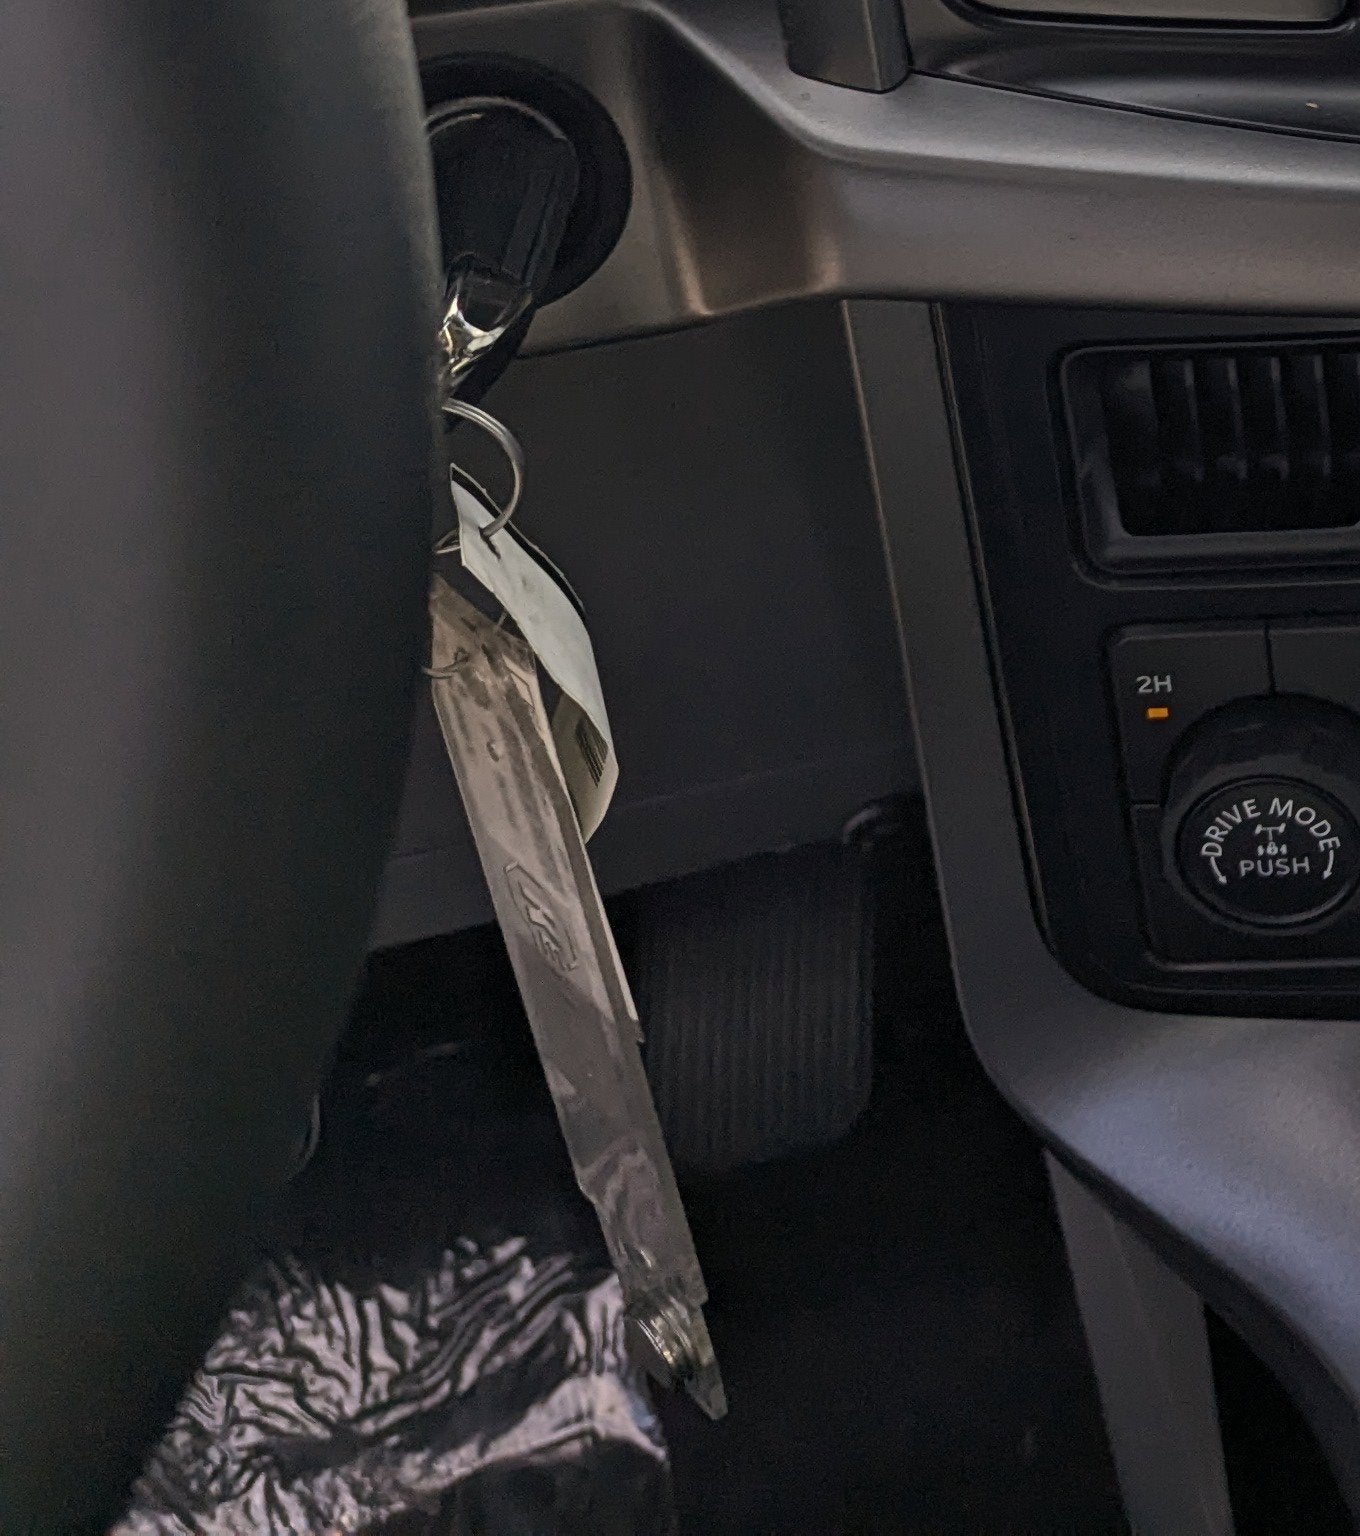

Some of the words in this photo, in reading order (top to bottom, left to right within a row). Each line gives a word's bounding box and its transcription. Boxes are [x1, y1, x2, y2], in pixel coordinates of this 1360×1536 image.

[1136, 674, 1173, 694] 2H
[1201, 798, 1262, 859] DRIVE
[1268, 797, 1342, 852] MODE
[1239, 856, 1310, 877] PUSH
